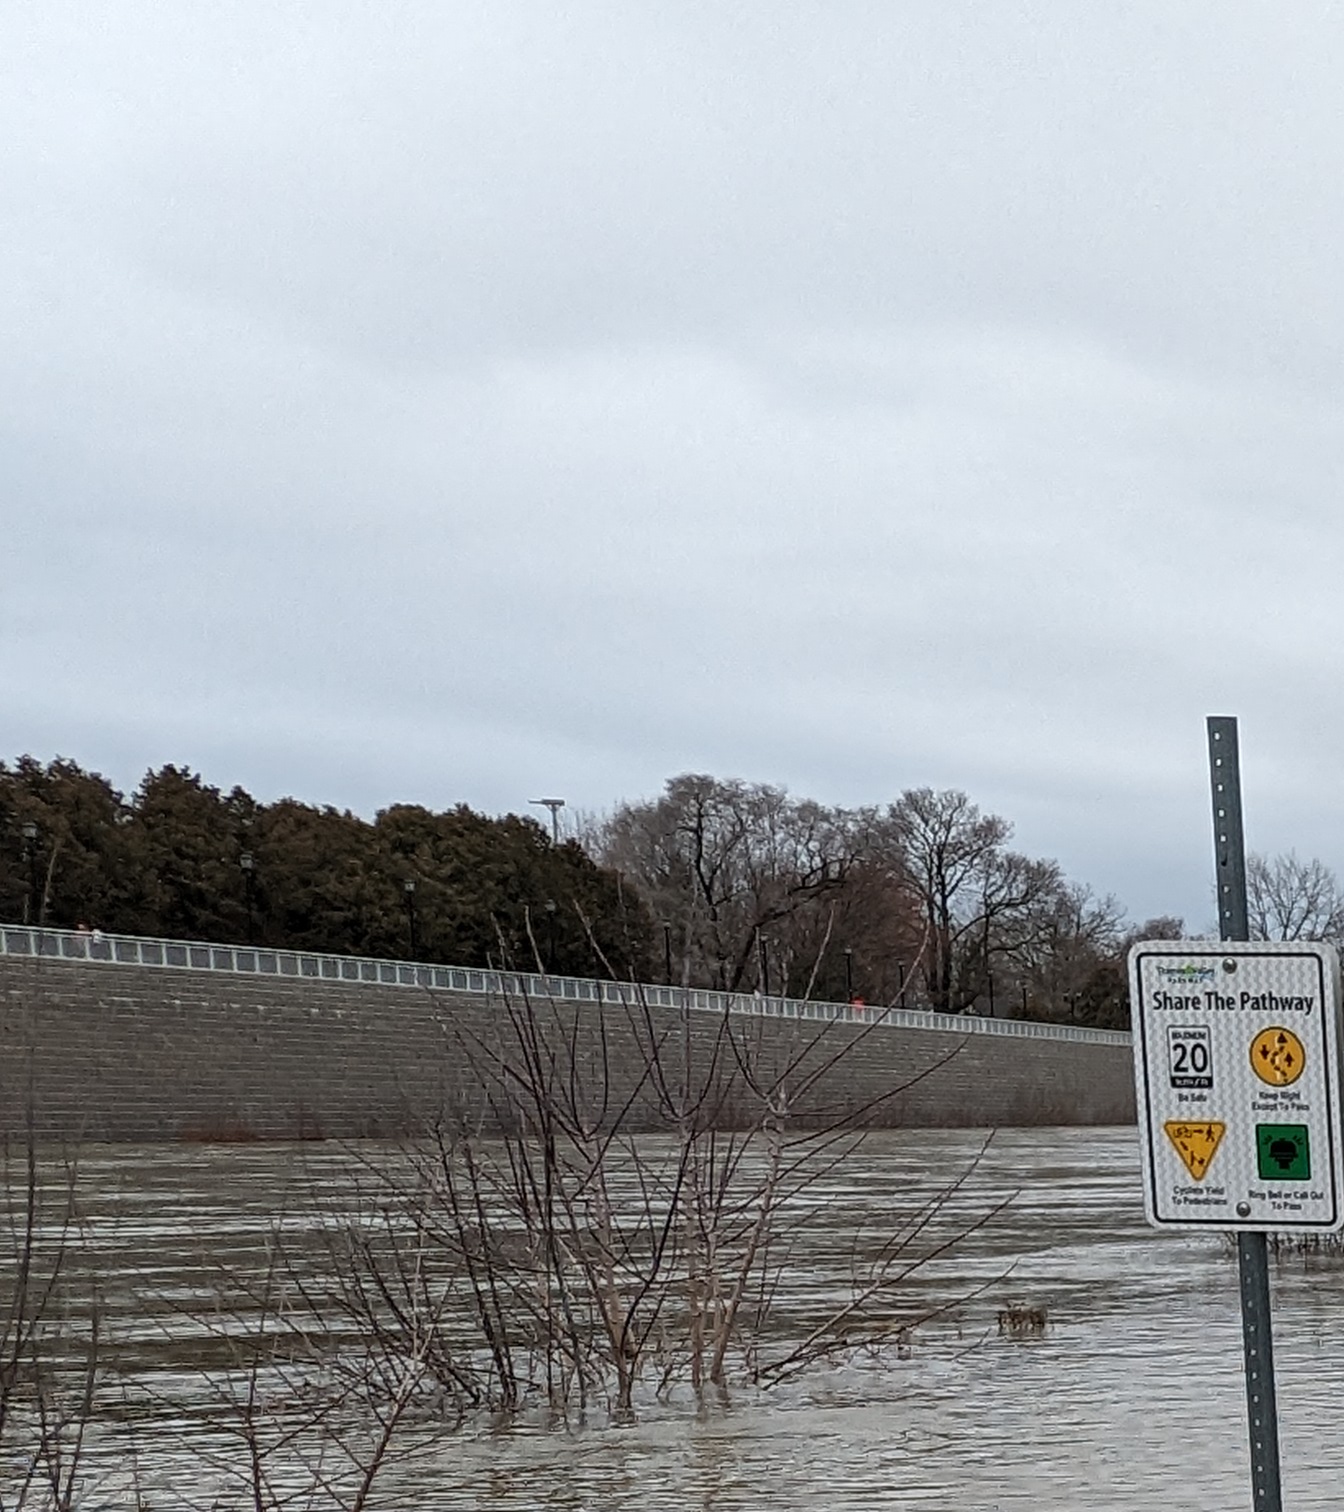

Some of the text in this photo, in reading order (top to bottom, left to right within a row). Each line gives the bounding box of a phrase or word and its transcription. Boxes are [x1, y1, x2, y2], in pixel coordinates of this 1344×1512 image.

[1153, 991, 1314, 1016] Share The Pathway
[1172, 1043, 1209, 1073] 20
